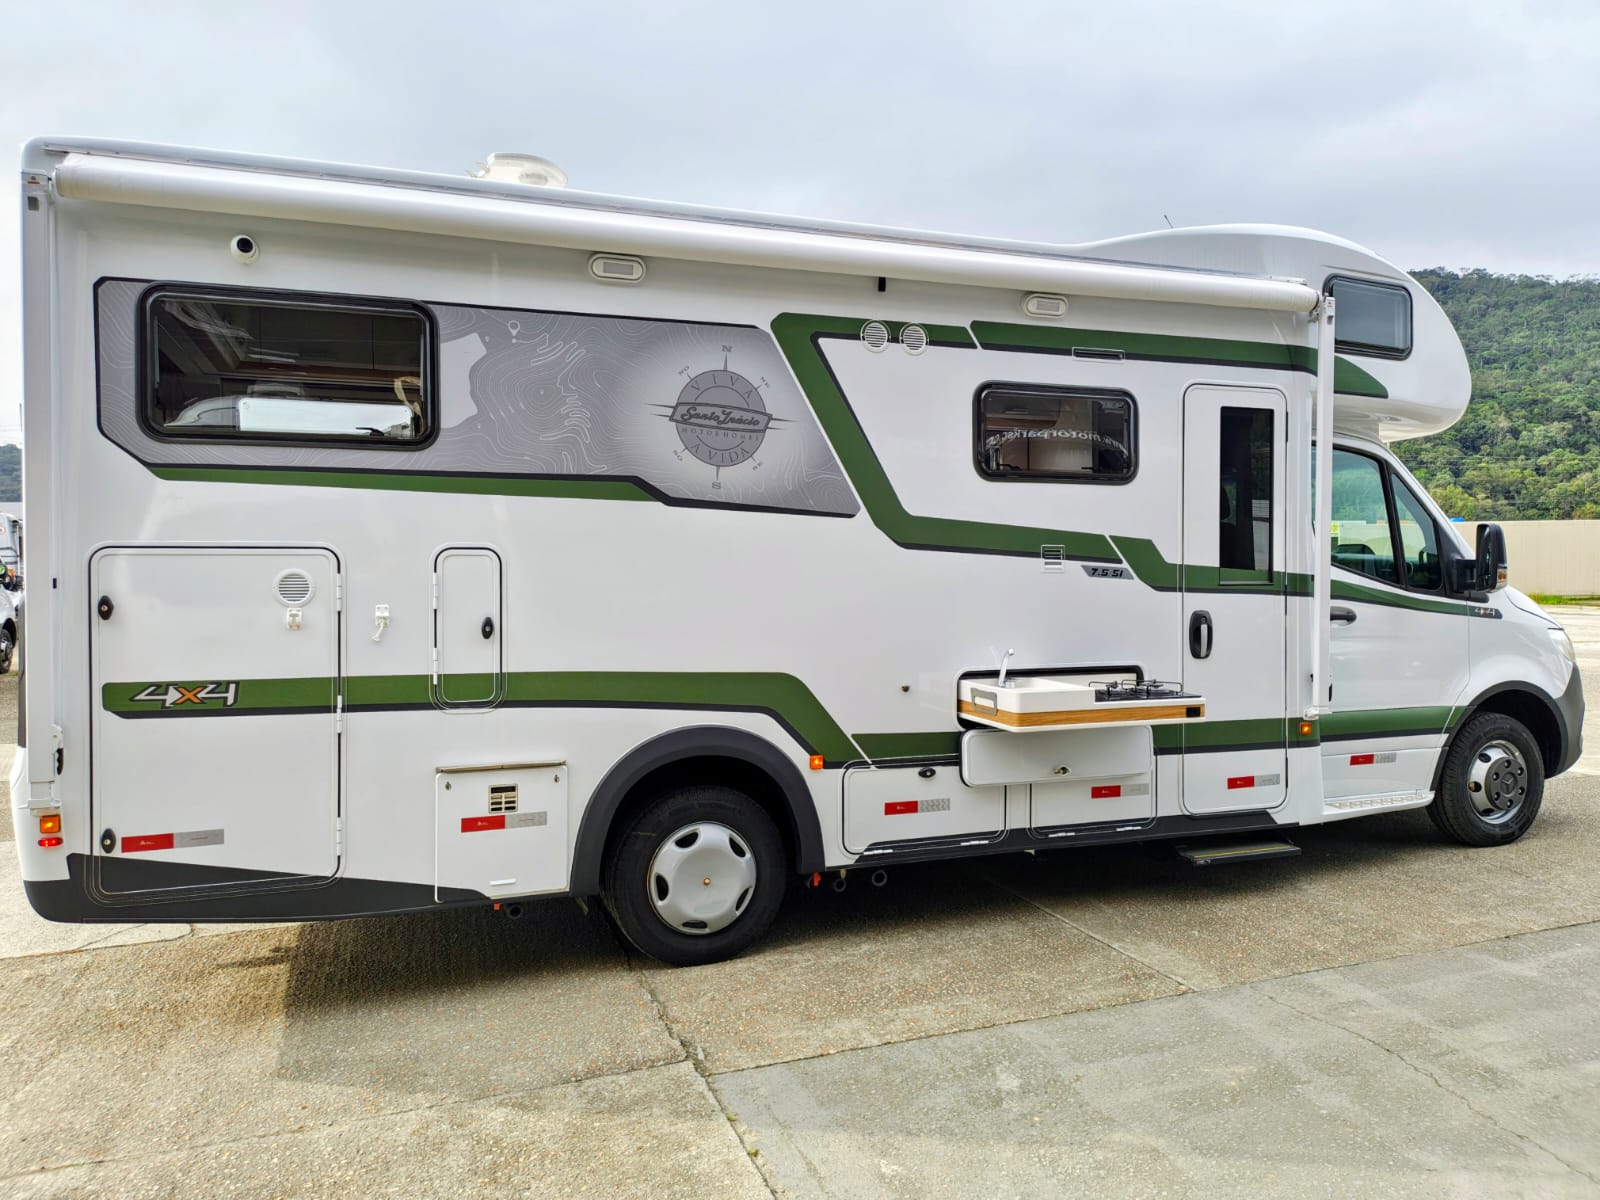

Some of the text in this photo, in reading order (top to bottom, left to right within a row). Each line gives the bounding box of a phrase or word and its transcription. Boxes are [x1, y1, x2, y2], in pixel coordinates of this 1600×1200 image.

[721, 344, 734, 353] N
[690, 373, 753, 399] VIVA
[680, 406, 721, 422] Santo
[690, 442, 750, 464] A VIDA
[711, 481, 722, 490] S
[1090, 567, 1110, 577] 7.5
